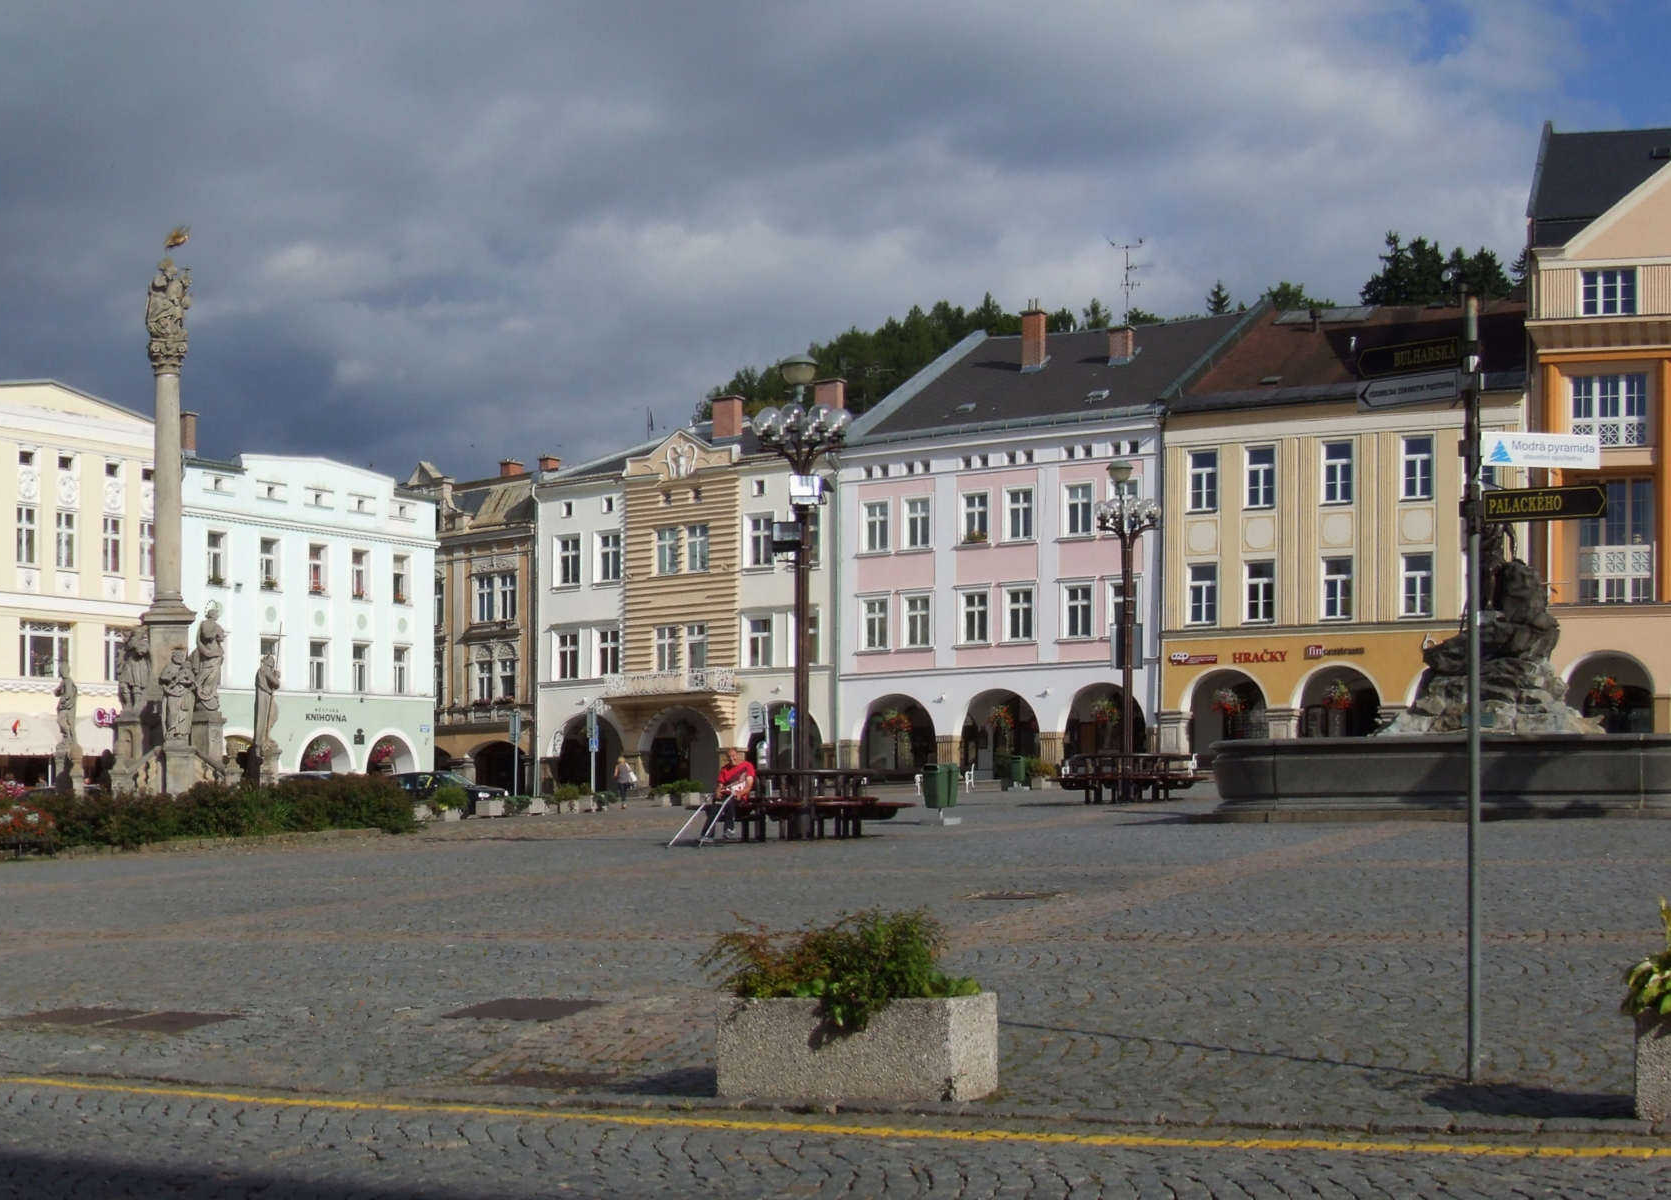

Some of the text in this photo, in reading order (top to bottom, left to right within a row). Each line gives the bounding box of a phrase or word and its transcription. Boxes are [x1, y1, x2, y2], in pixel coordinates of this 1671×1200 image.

[1393, 340, 1457, 367] BULHARSKÁ
[1511, 440, 1595, 454] Modrá pyramida
[1489, 492, 1562, 514] PALACKÉHO
[1232, 649, 1288, 664] HRAČKY
[94, 708, 118, 724] Caf
[305, 713, 348, 723] KNIHOVNA
